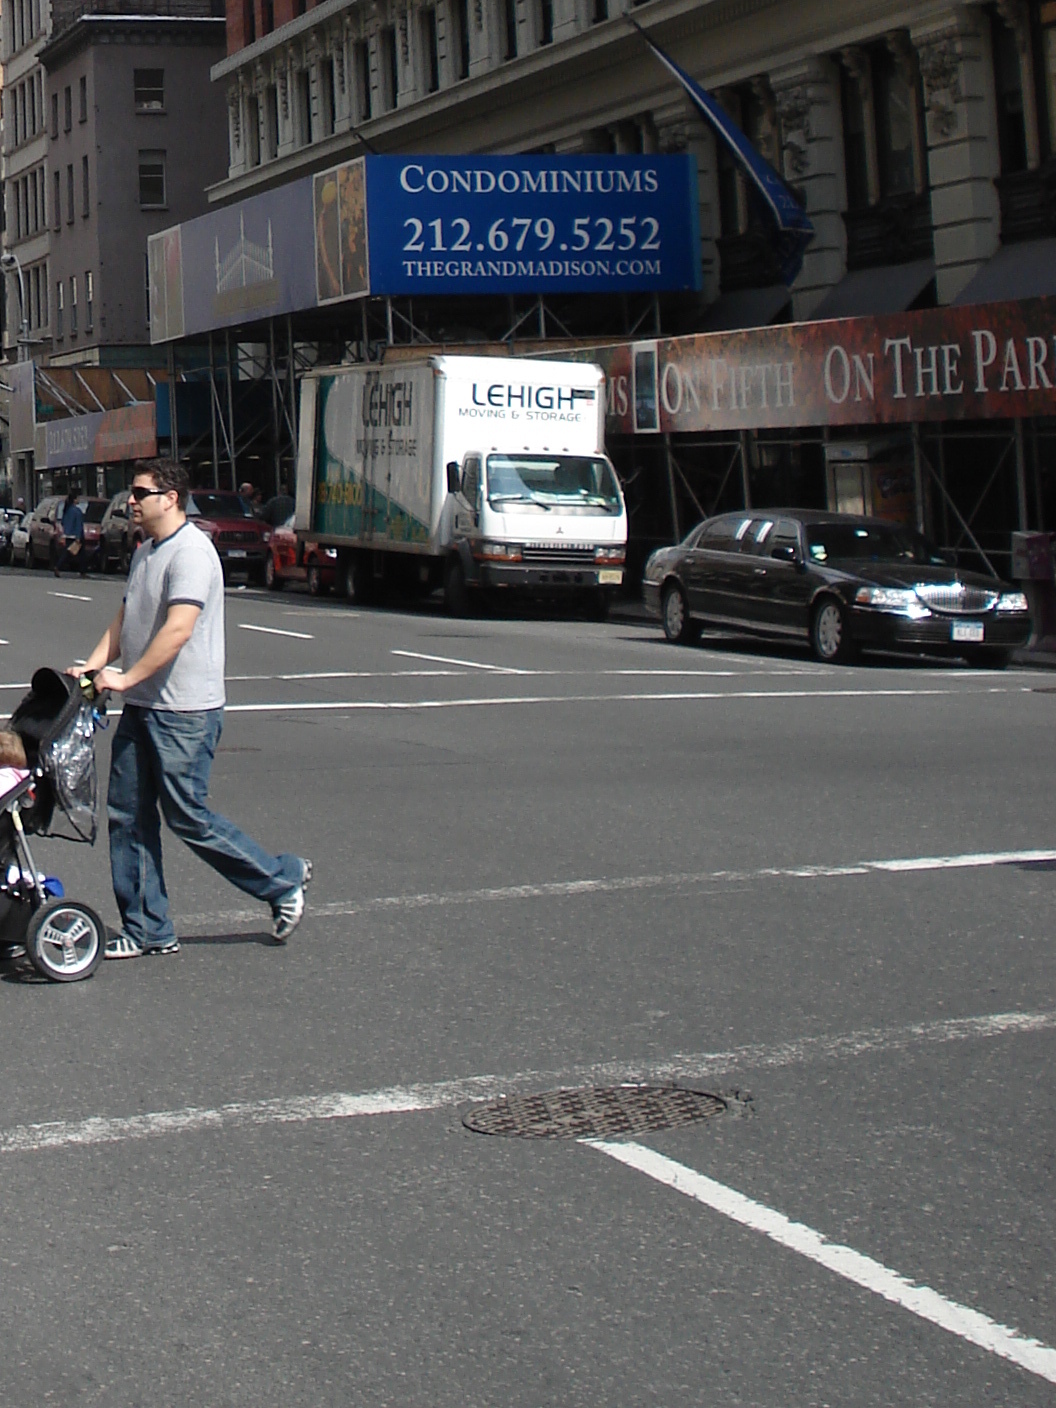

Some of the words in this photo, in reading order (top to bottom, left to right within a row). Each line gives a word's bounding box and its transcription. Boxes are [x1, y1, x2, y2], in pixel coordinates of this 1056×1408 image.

[399, 164, 658, 193] CONDOMINIUMS
[402, 215, 662, 252] 212.679.5252
[402, 259, 662, 277] THEGRANDMADISON.COM
[823, 345, 875, 404] ON
[884, 335, 964, 399] THE
[971, 329, 1056, 393] PAR
[472, 382, 574, 410] LEHIGH
[661, 362, 701, 414] ON
[709, 358, 795, 411] FIFTH
[458, 408, 506, 419] MOVING
[511, 410, 520, 420] &
[526, 411, 582, 422] STORAGE
